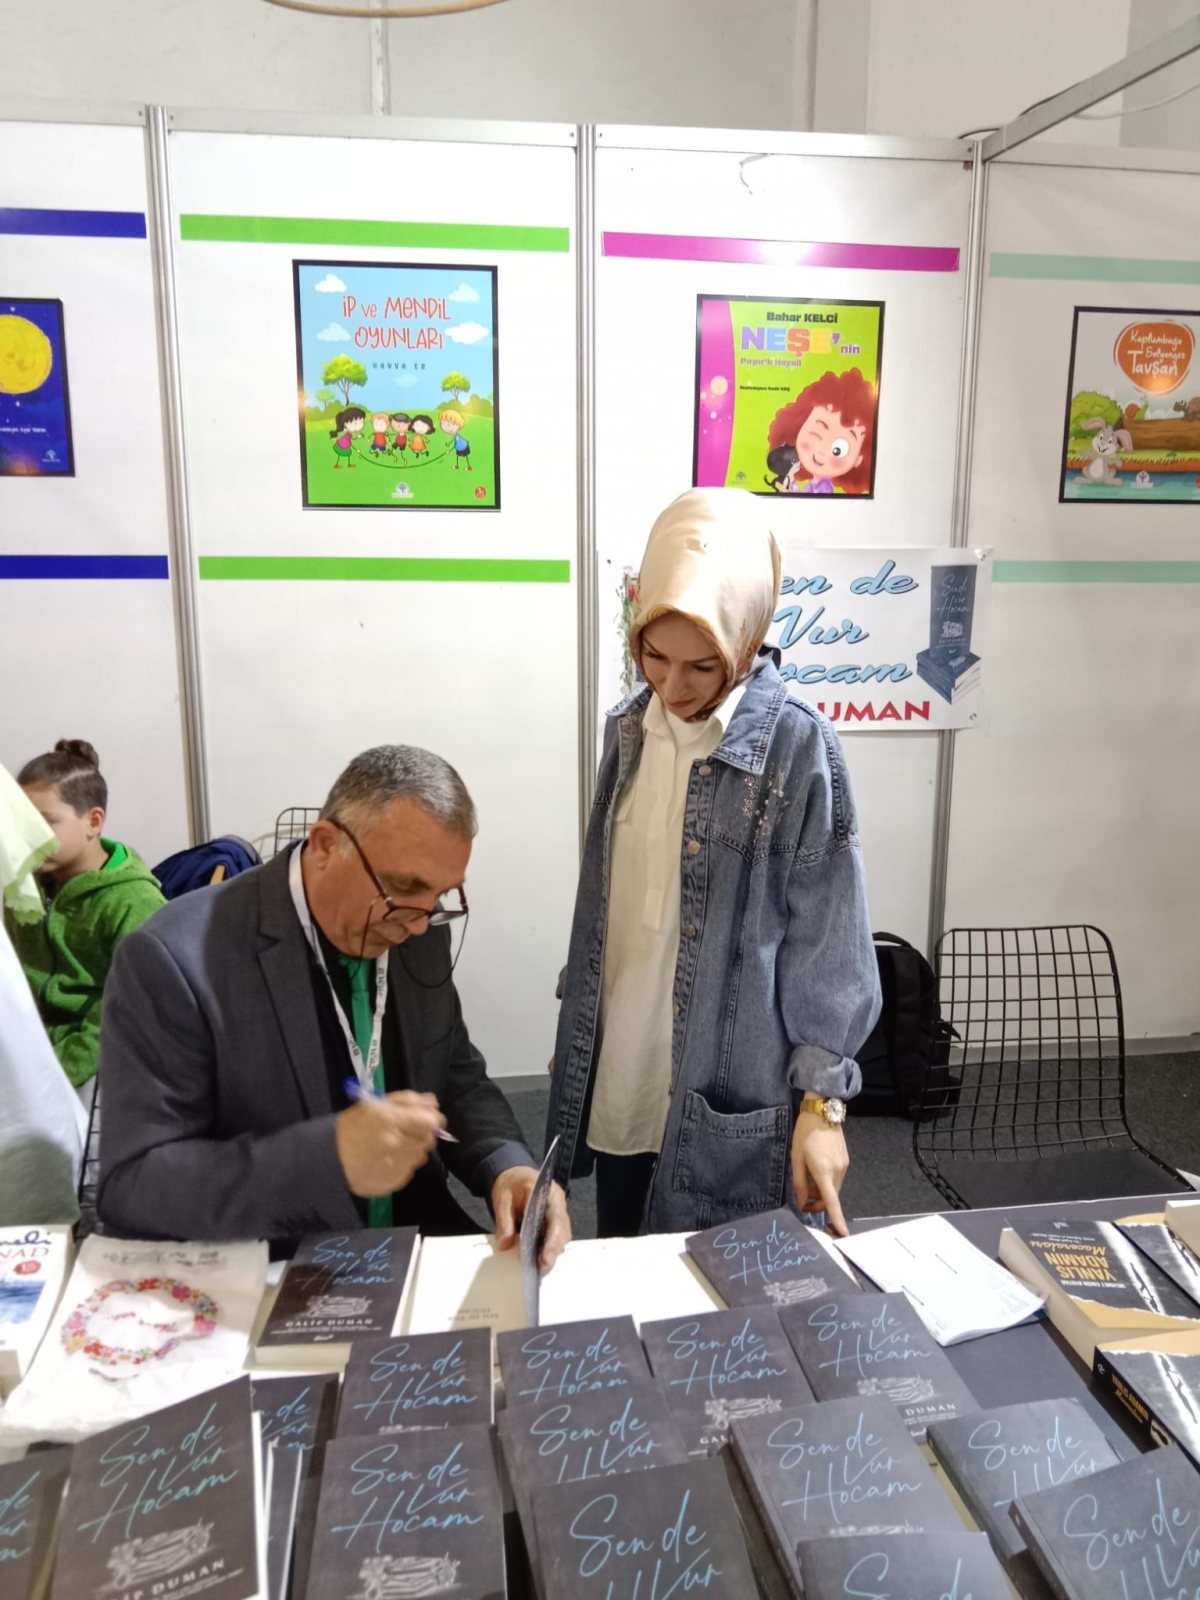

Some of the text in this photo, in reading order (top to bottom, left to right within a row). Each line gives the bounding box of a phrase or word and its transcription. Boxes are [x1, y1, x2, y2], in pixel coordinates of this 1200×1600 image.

[361, 303, 377, 319] ve
[384, 296, 451, 320] MENDİL
[767, 312, 801, 322] Bahar
[354, 325, 443, 350] OYUNLARI
[372, 362, 407, 370] HAVVA
[1127, 350, 1178, 379] Tavşan
[780, 559, 919, 596] en de
[772, 605, 869, 650] Vur
[779, 663, 912, 685] ocam
[817, 701, 930, 722] UMAN
[312, 1236, 393, 1263] Sen de
[713, 1219, 791, 1259] Sen de
[294, 1263, 396, 1293] Hocam
[729, 1250, 820, 1285] Hocam
[1044, 1252, 1109, 1268] ADAMIN
[327, 1318, 373, 1327] DUMAN
[666, 1318, 762, 1359] Sen de
[807, 1303, 866, 1341] Sen
[872, 1303, 902, 1333] de
[370, 1340, 467, 1382] Sen de
[521, 1328, 618, 1369] Sen de
[819, 1334, 931, 1377] Hocam
[670, 1354, 787, 1398] Hocam
[276, 1386, 312, 1423] de
[353, 1377, 478, 1424] Hocam
[905, 1403, 956, 1416] DUMAN
[99, 1424, 174, 1487] Sen
[180, 1401, 223, 1456] de
[530, 1397, 647, 1456] Sen de
[767, 1412, 882, 1470] Sen de
[968, 1415, 1082, 1470] Sen de
[350, 1441, 470, 1495] Sen de
[77, 1468, 239, 1543] Hocam
[781, 1462, 922, 1525] Hocam
[330, 1490, 484, 1554] Hocam
[569, 1489, 707, 1577] Sen de
[1063, 1477, 1191, 1571] Sen de
[152, 1557, 225, 1595] DUMAN
